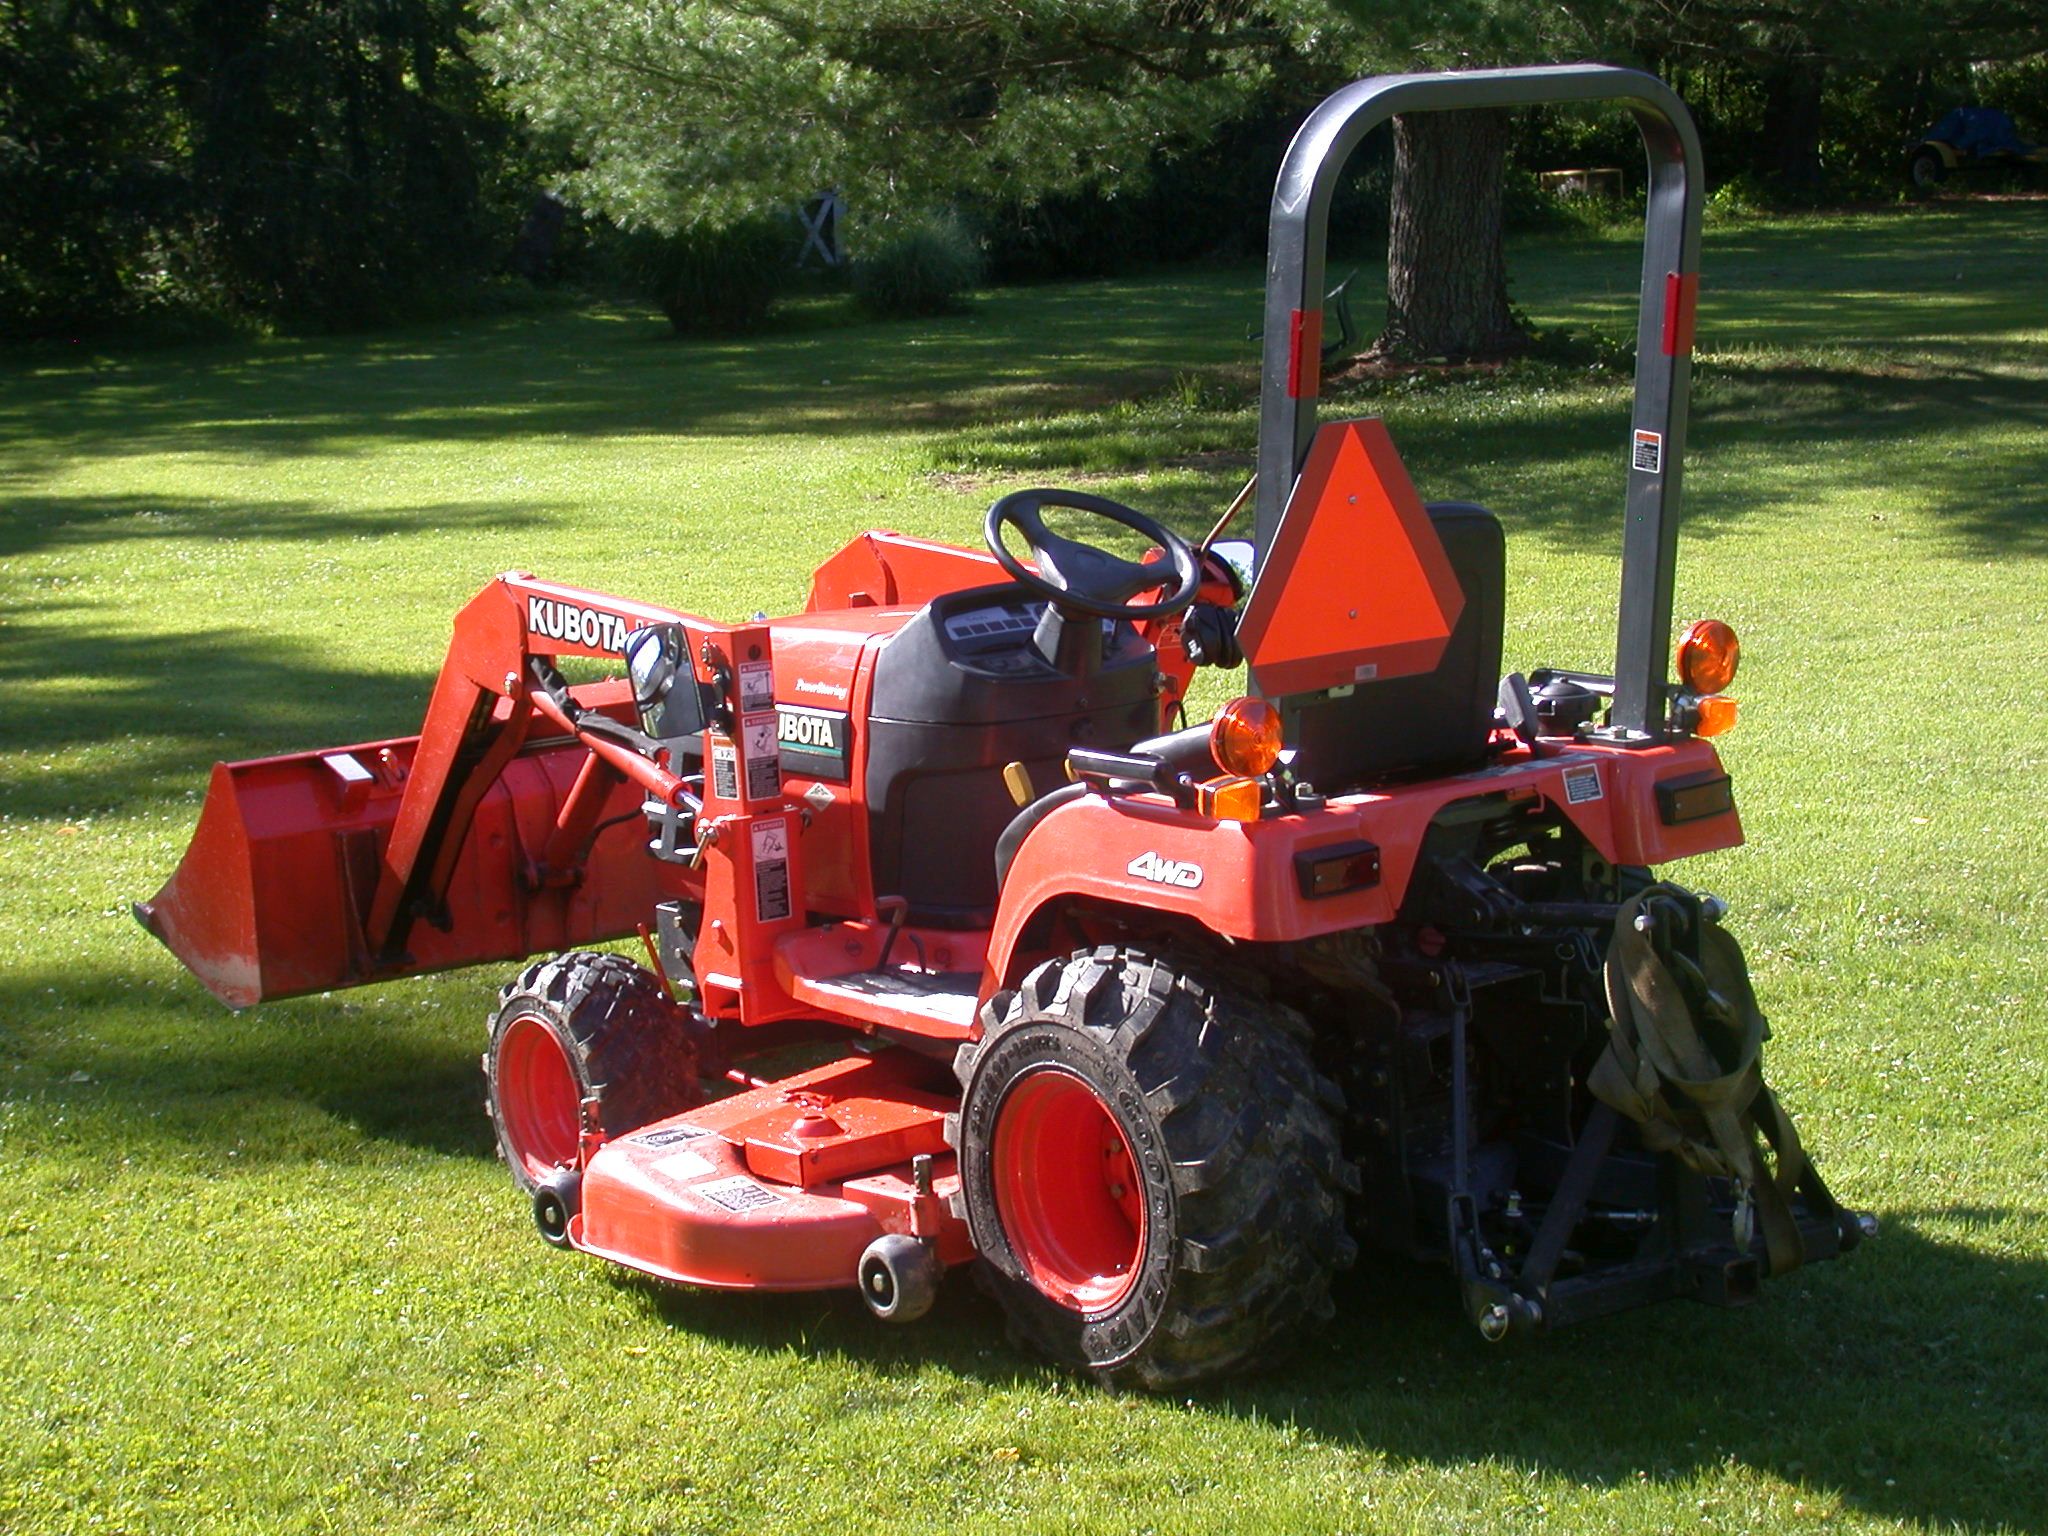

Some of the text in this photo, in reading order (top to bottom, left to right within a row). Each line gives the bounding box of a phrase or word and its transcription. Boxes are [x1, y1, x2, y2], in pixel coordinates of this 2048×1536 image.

[528, 595, 627, 653] KUBOTA
[777, 712, 834, 747] UBOTA
[1127, 851, 1204, 889] 4WD
